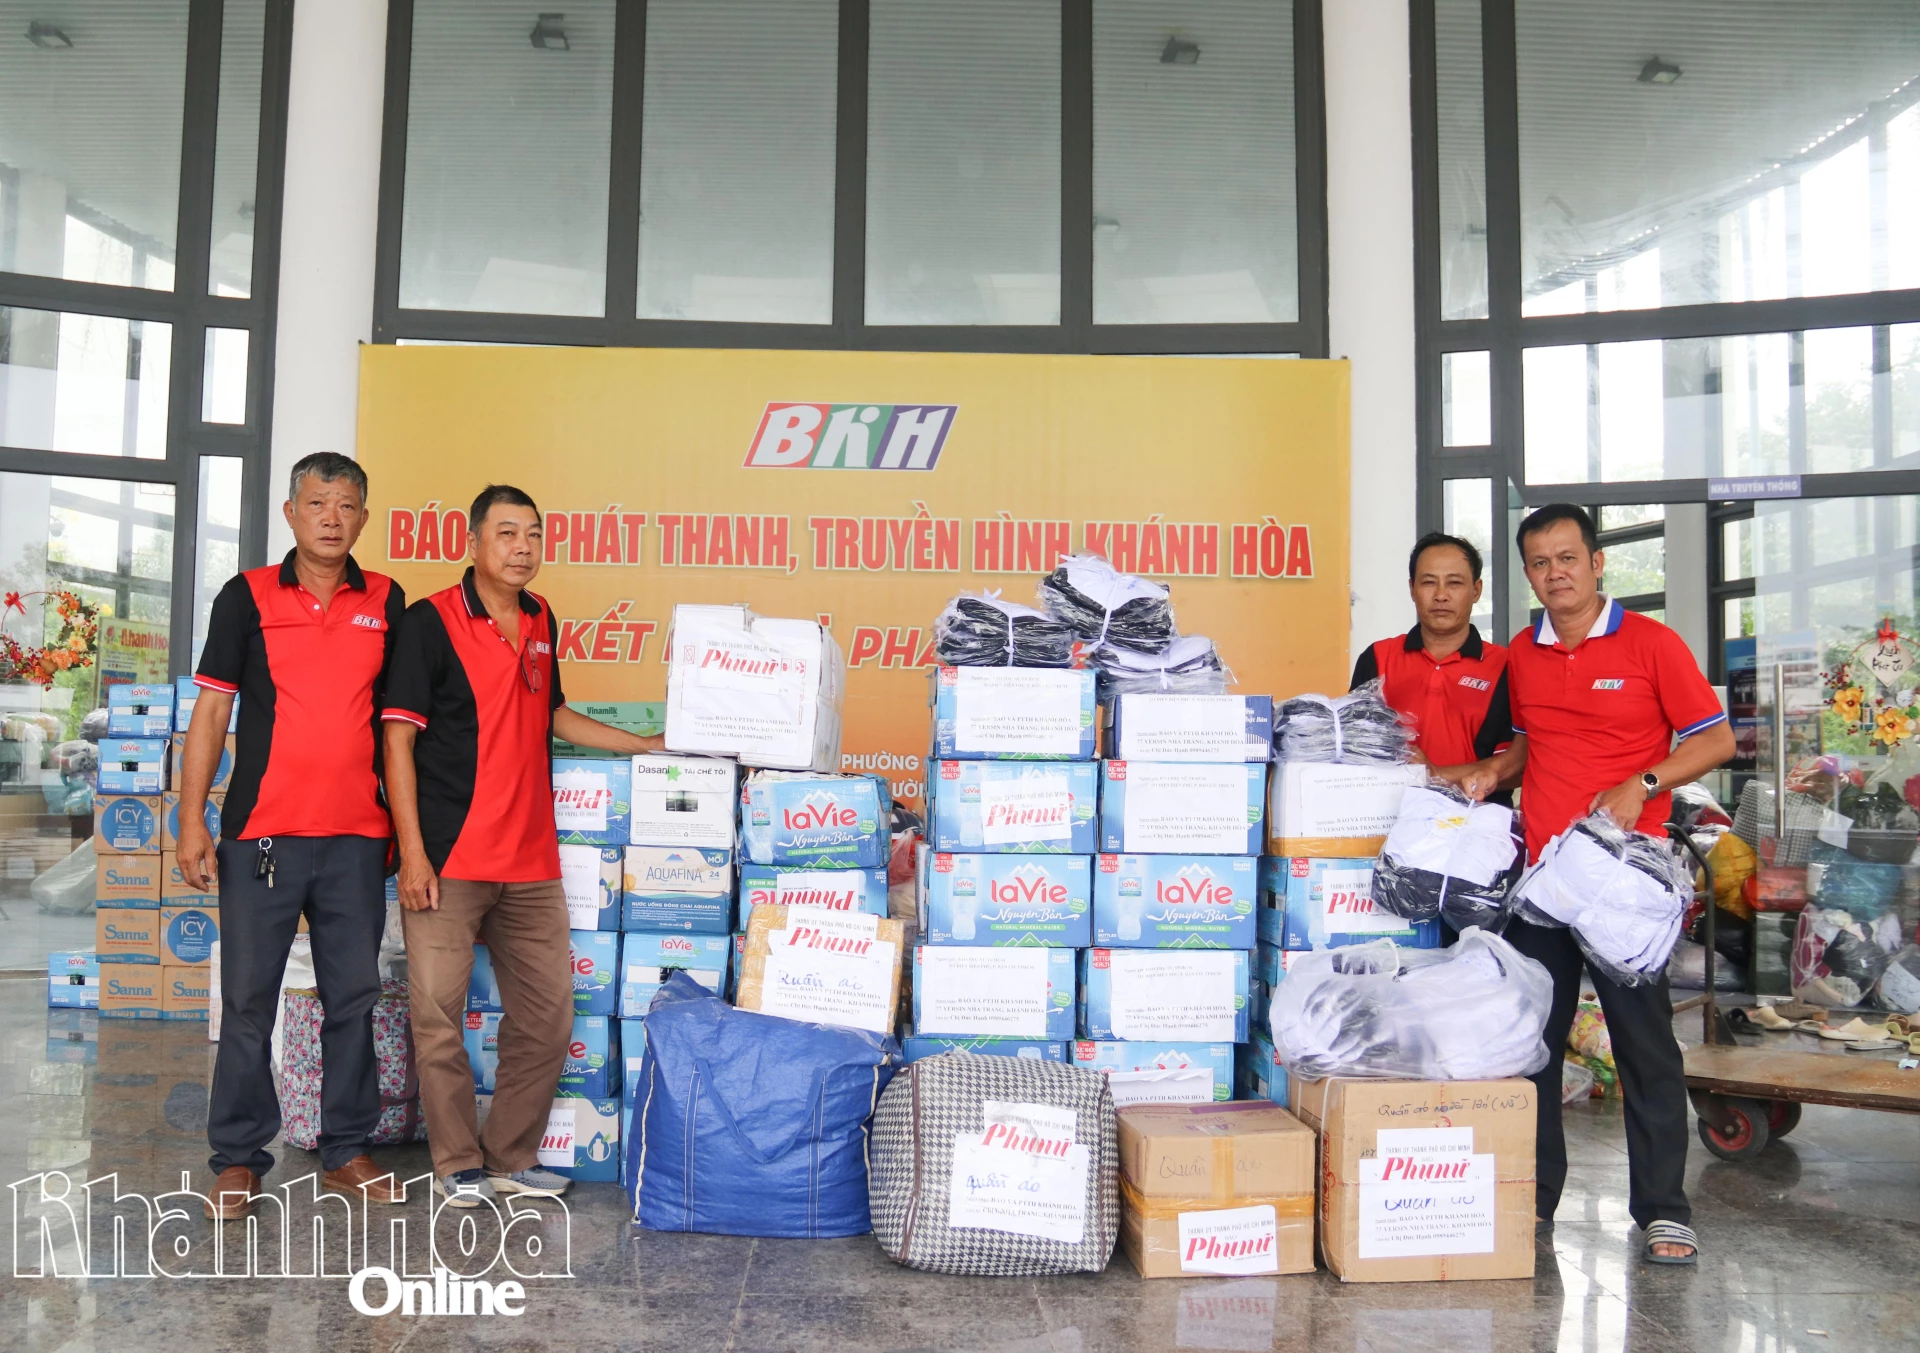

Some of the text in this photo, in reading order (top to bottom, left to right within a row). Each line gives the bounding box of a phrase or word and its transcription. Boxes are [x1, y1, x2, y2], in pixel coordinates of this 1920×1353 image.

[388, 501, 1315, 579] BÁO PHÁT THANH, TRUYỀN HÌNH KHÁNH HÒA
[352, 613, 382, 629] BKH
[557, 600, 657, 664] KẾT
[1459, 676, 1490, 691] BKH
[131, 688, 150, 697] laVie
[587, 706, 618, 715] Vinamilk
[120, 744, 141, 753] laVie
[841, 750, 919, 771] PHƯỜNG
[638, 765, 670, 776] Dasani
[697, 766, 712, 775] CHẾ
[714, 767, 726, 775] TÔI
[115, 808, 142, 824] ICY
[783, 802, 857, 830] laVie
[790, 833, 833, 848] Nguyên
[105, 869, 150, 886] Sanna
[645, 866, 720, 883] AQUAFINA 24
[956, 880, 973, 888] laVie
[991, 876, 1068, 903] laVie
[1121, 880, 1139, 888] laVie
[1157, 877, 1233, 904] laVie
[992, 908, 1065, 924] Nguyên Bản
[1158, 908, 1230, 924] Nguyên Bản
[104, 924, 149, 941] Sanna
[180, 920, 207, 937] ICY
[661, 938, 692, 951] laVie
[68, 957, 87, 966] laVie
[107, 979, 152, 996] Sanna
[172, 981, 210, 997] Sann
[561, 1062, 584, 1075] Bản
[1457, 1144, 1471, 1152] MINH
[1426, 1213, 1443, 1221] PTTH
